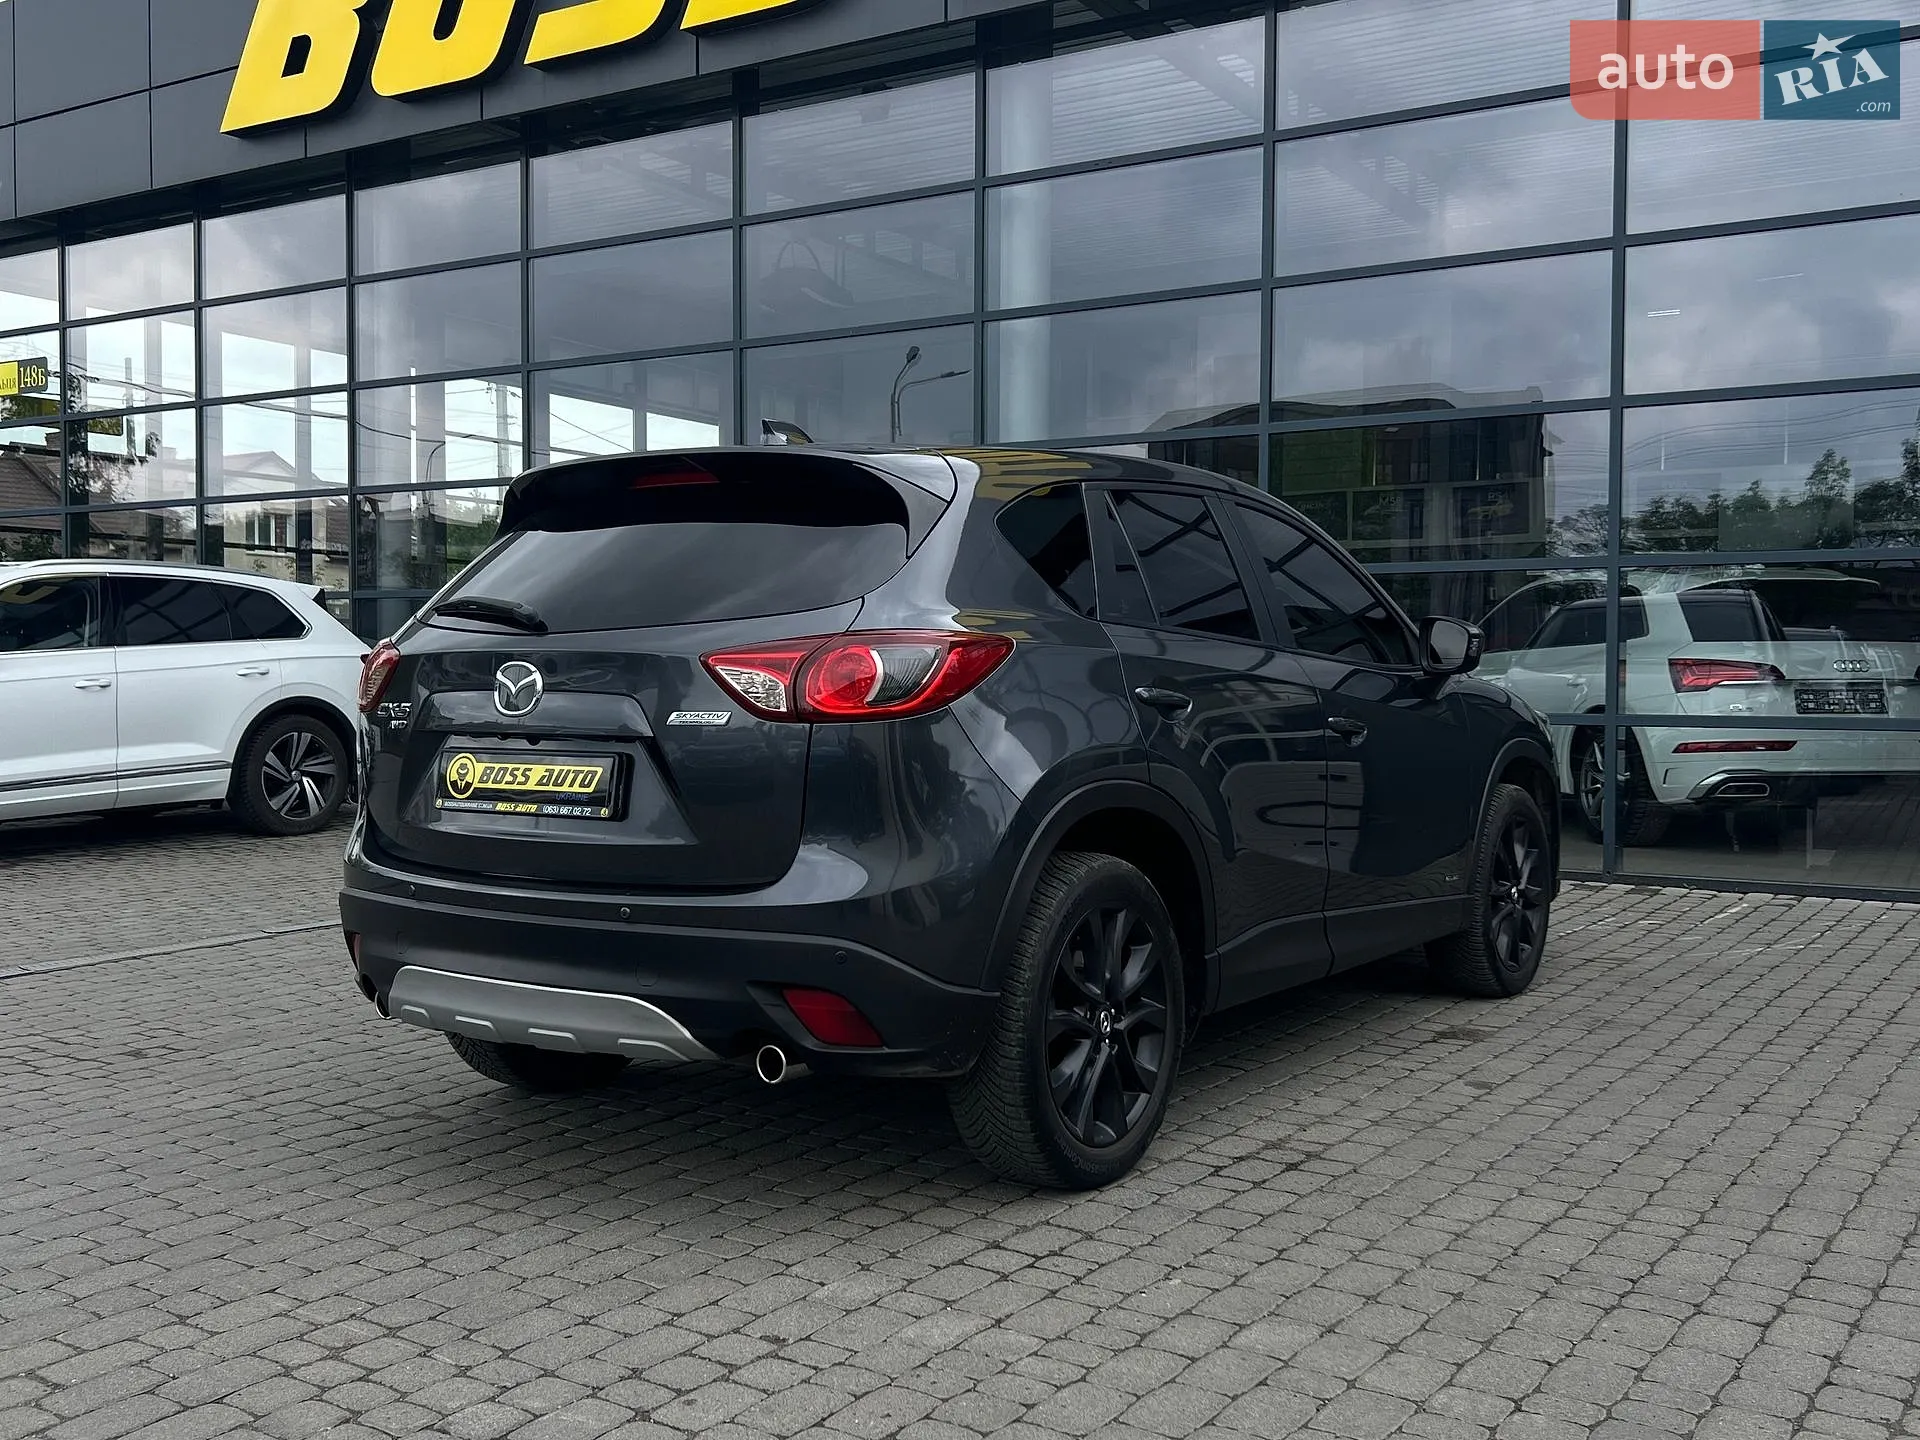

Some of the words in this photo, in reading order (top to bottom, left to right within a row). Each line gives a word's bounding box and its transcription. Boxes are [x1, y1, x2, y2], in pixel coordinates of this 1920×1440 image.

[478, 766, 533, 786] BOSS
[534, 768, 599, 789] AUTO
[555, 792, 590, 801] UKRAINE
